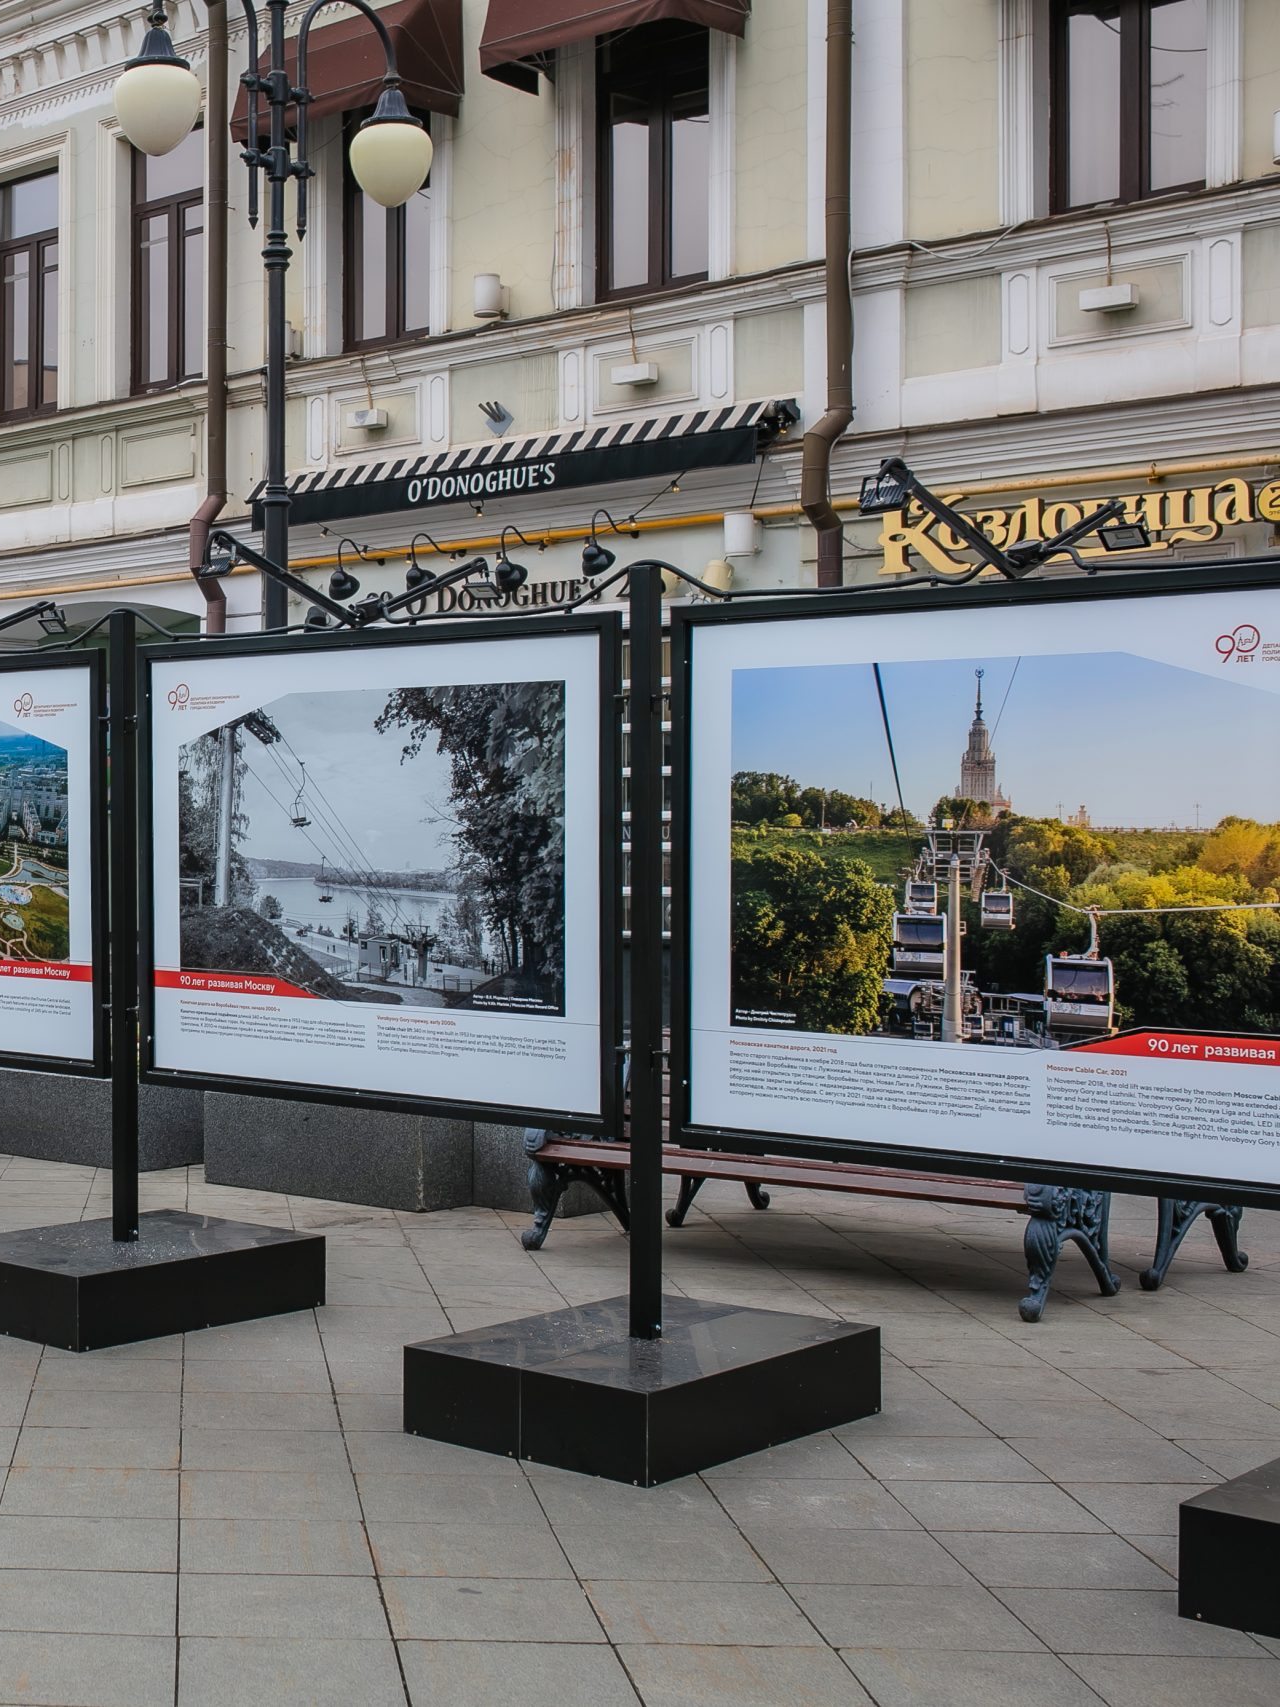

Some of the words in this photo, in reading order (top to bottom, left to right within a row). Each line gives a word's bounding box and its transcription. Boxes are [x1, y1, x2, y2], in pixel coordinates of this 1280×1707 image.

[408, 462, 556, 502] O'DONOGHUE'S
[1236, 654, 1255, 662] ЛЕТ
[13, 967, 44, 975] развивая
[44, 967, 71, 979] Москву
[180, 976, 191, 985] 90
[208, 980, 243, 989] развивая
[244, 980, 275, 993] Москву
[1148, 1038, 1169, 1052] 90
[1171, 1043, 1198, 1054] лет
[1204, 1045, 1276, 1059] развивая
[1053, 1077, 1086, 1085] November
[1046, 1085, 1078, 1094] Vorobyovy
[1079, 1087, 1094, 1096] Gory
[1215, 1098, 1230, 1107] long
[1137, 1101, 1173, 1111] Vorobyovy
[1194, 1106, 1219, 1114] Novaya
[1221, 1108, 1236, 1116] Liga
[1056, 1111, 1083, 1119] bicycles,
[1151, 1119, 1170, 1127] Since
[1171, 1121, 1195, 1130] August
[1197, 1123, 1215, 1131] 2021,
[1082, 1122, 1109, 1131] enabling
[1118, 1125, 1132, 1133] fully
[1183, 1131, 1201, 1139] flight
[1219, 1134, 1256, 1145] Vorobyovy
[1257, 1138, 1275, 1147] Gory
